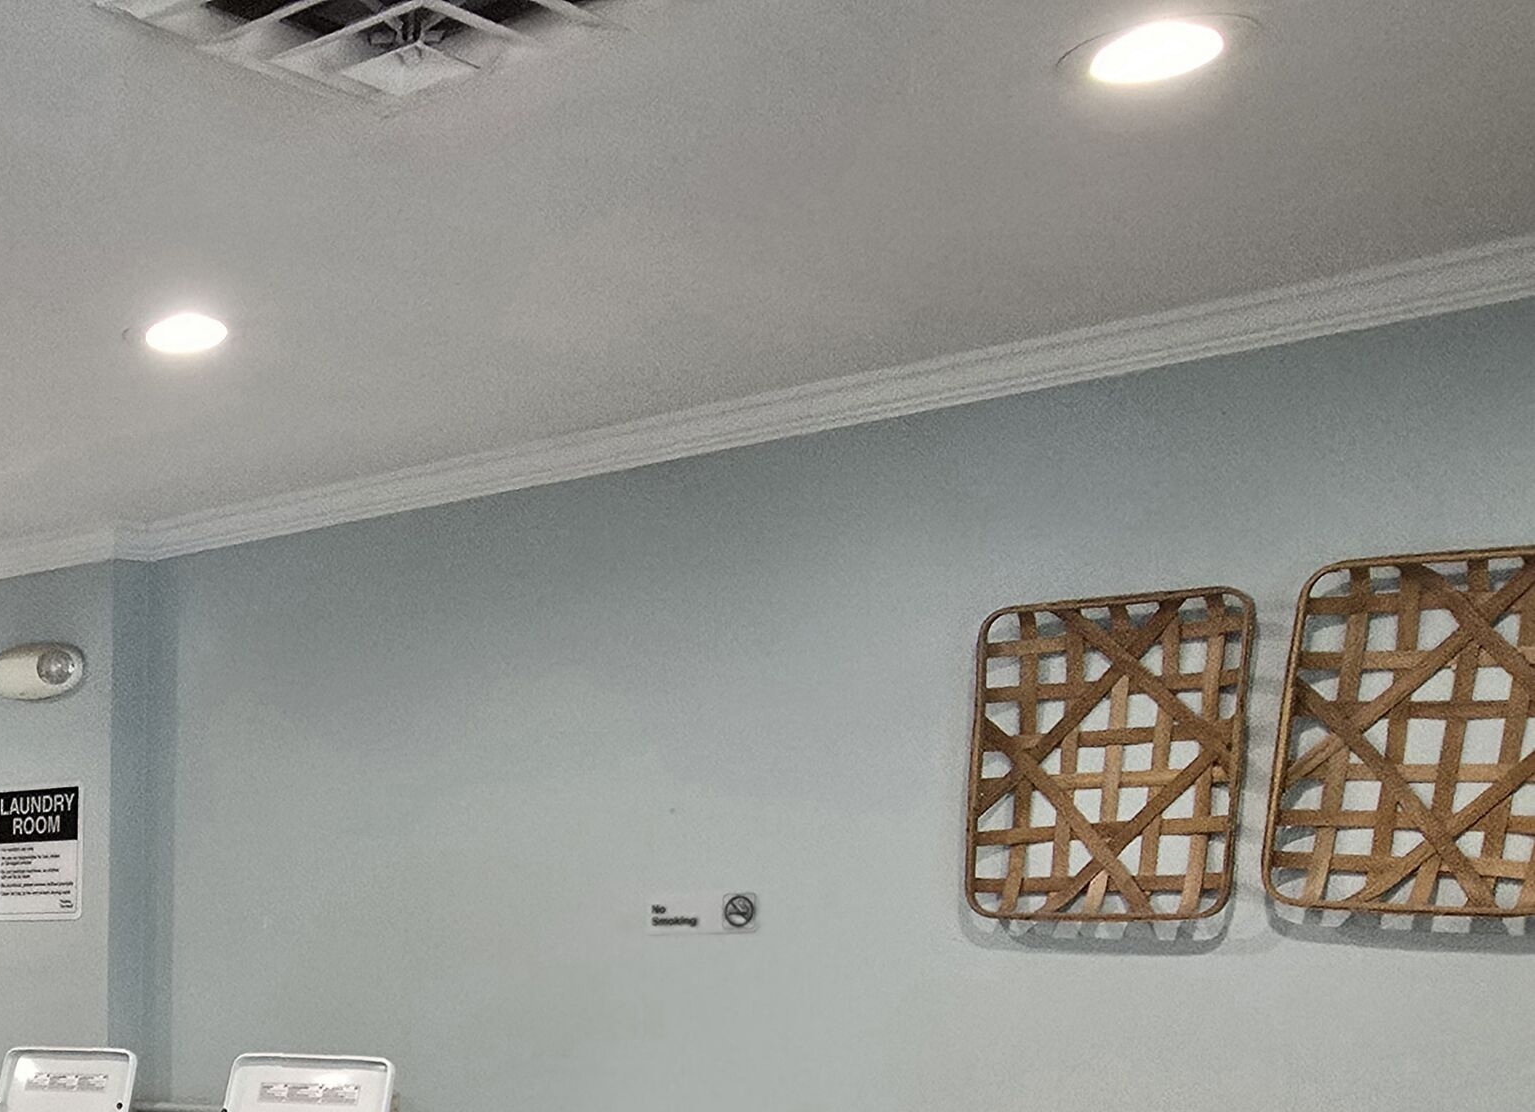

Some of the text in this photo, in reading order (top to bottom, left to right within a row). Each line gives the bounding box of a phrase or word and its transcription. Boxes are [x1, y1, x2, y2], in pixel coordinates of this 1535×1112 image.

[0, 793, 75, 815] LAUNDRY
[12, 815, 61, 835] ROOM
[651, 904, 666, 914] No
[651, 916, 698, 927] Smoking
